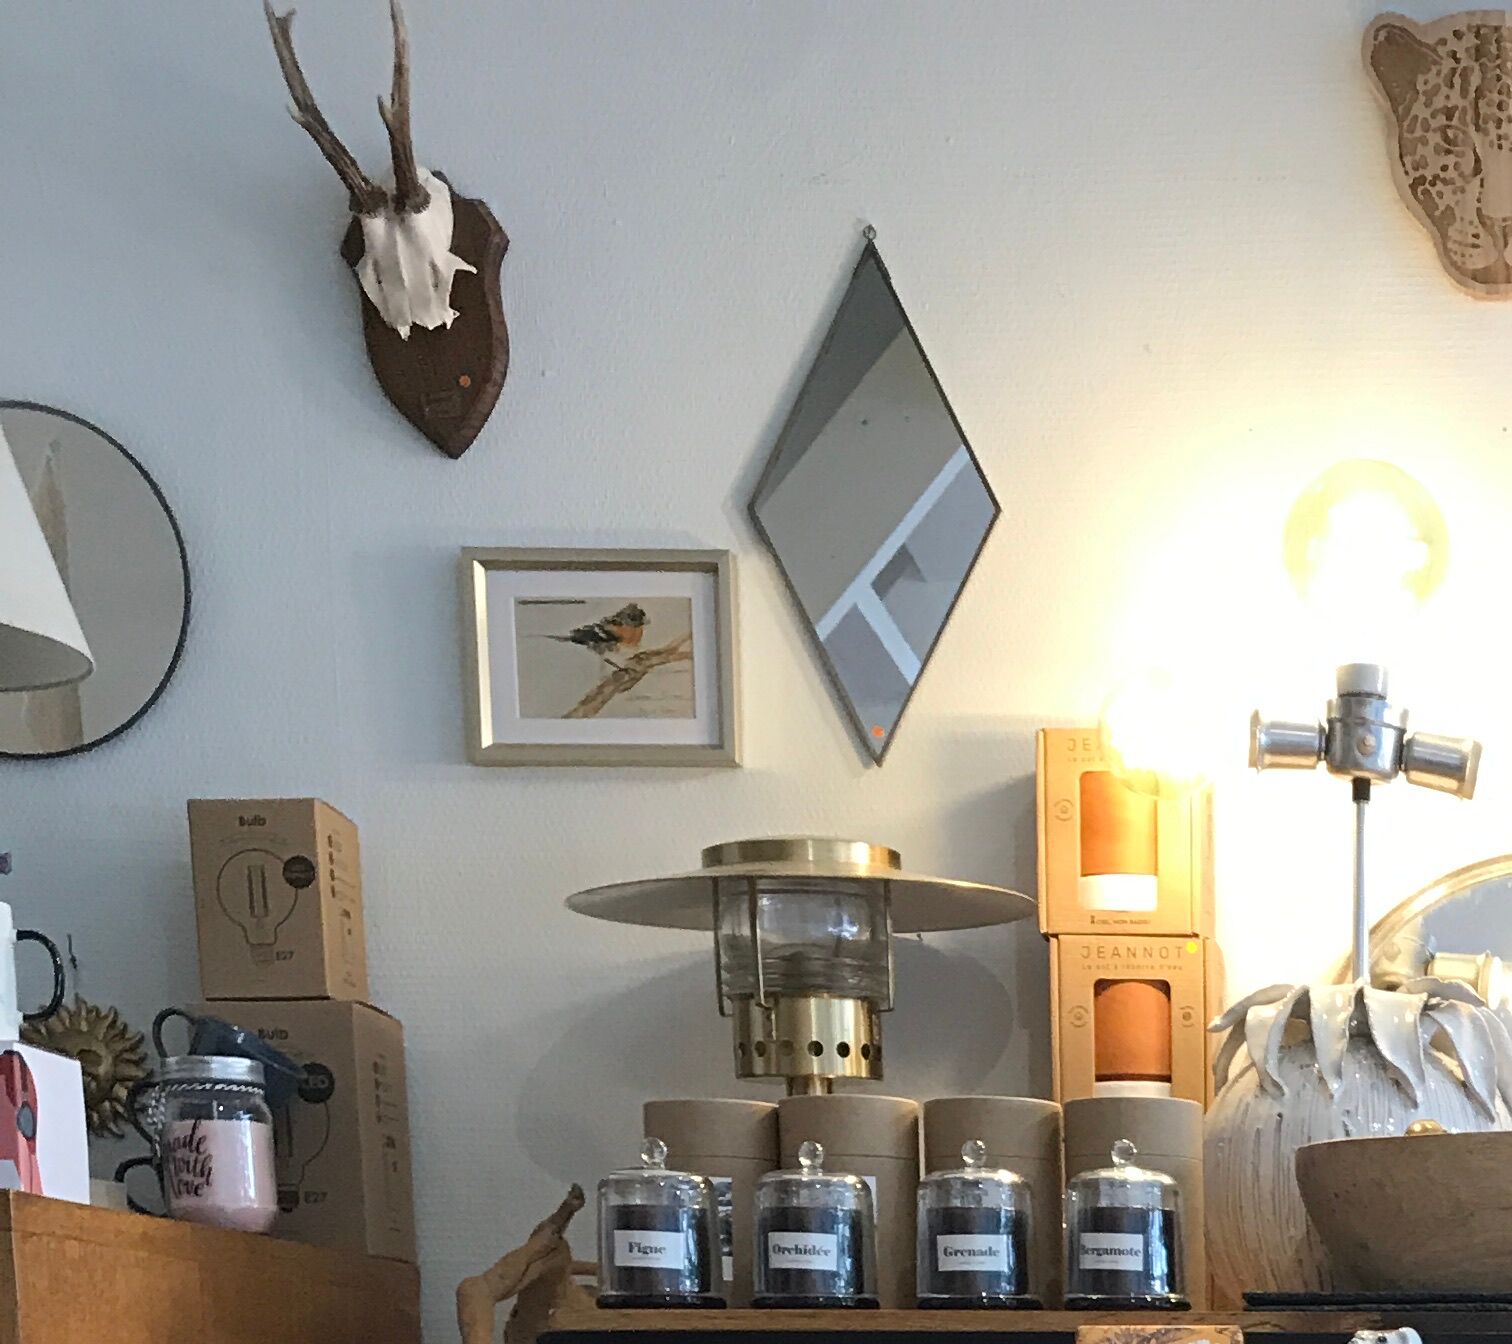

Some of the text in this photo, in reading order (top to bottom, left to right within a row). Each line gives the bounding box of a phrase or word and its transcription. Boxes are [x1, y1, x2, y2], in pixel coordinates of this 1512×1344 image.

[238, 815, 267, 827] Bulb
[1080, 945, 1184, 959] JEANNOT
[627, 1241, 666, 1255] Figue
[771, 1243, 831, 1257] Orchidée
[943, 1245, 1001, 1257] Grenade
